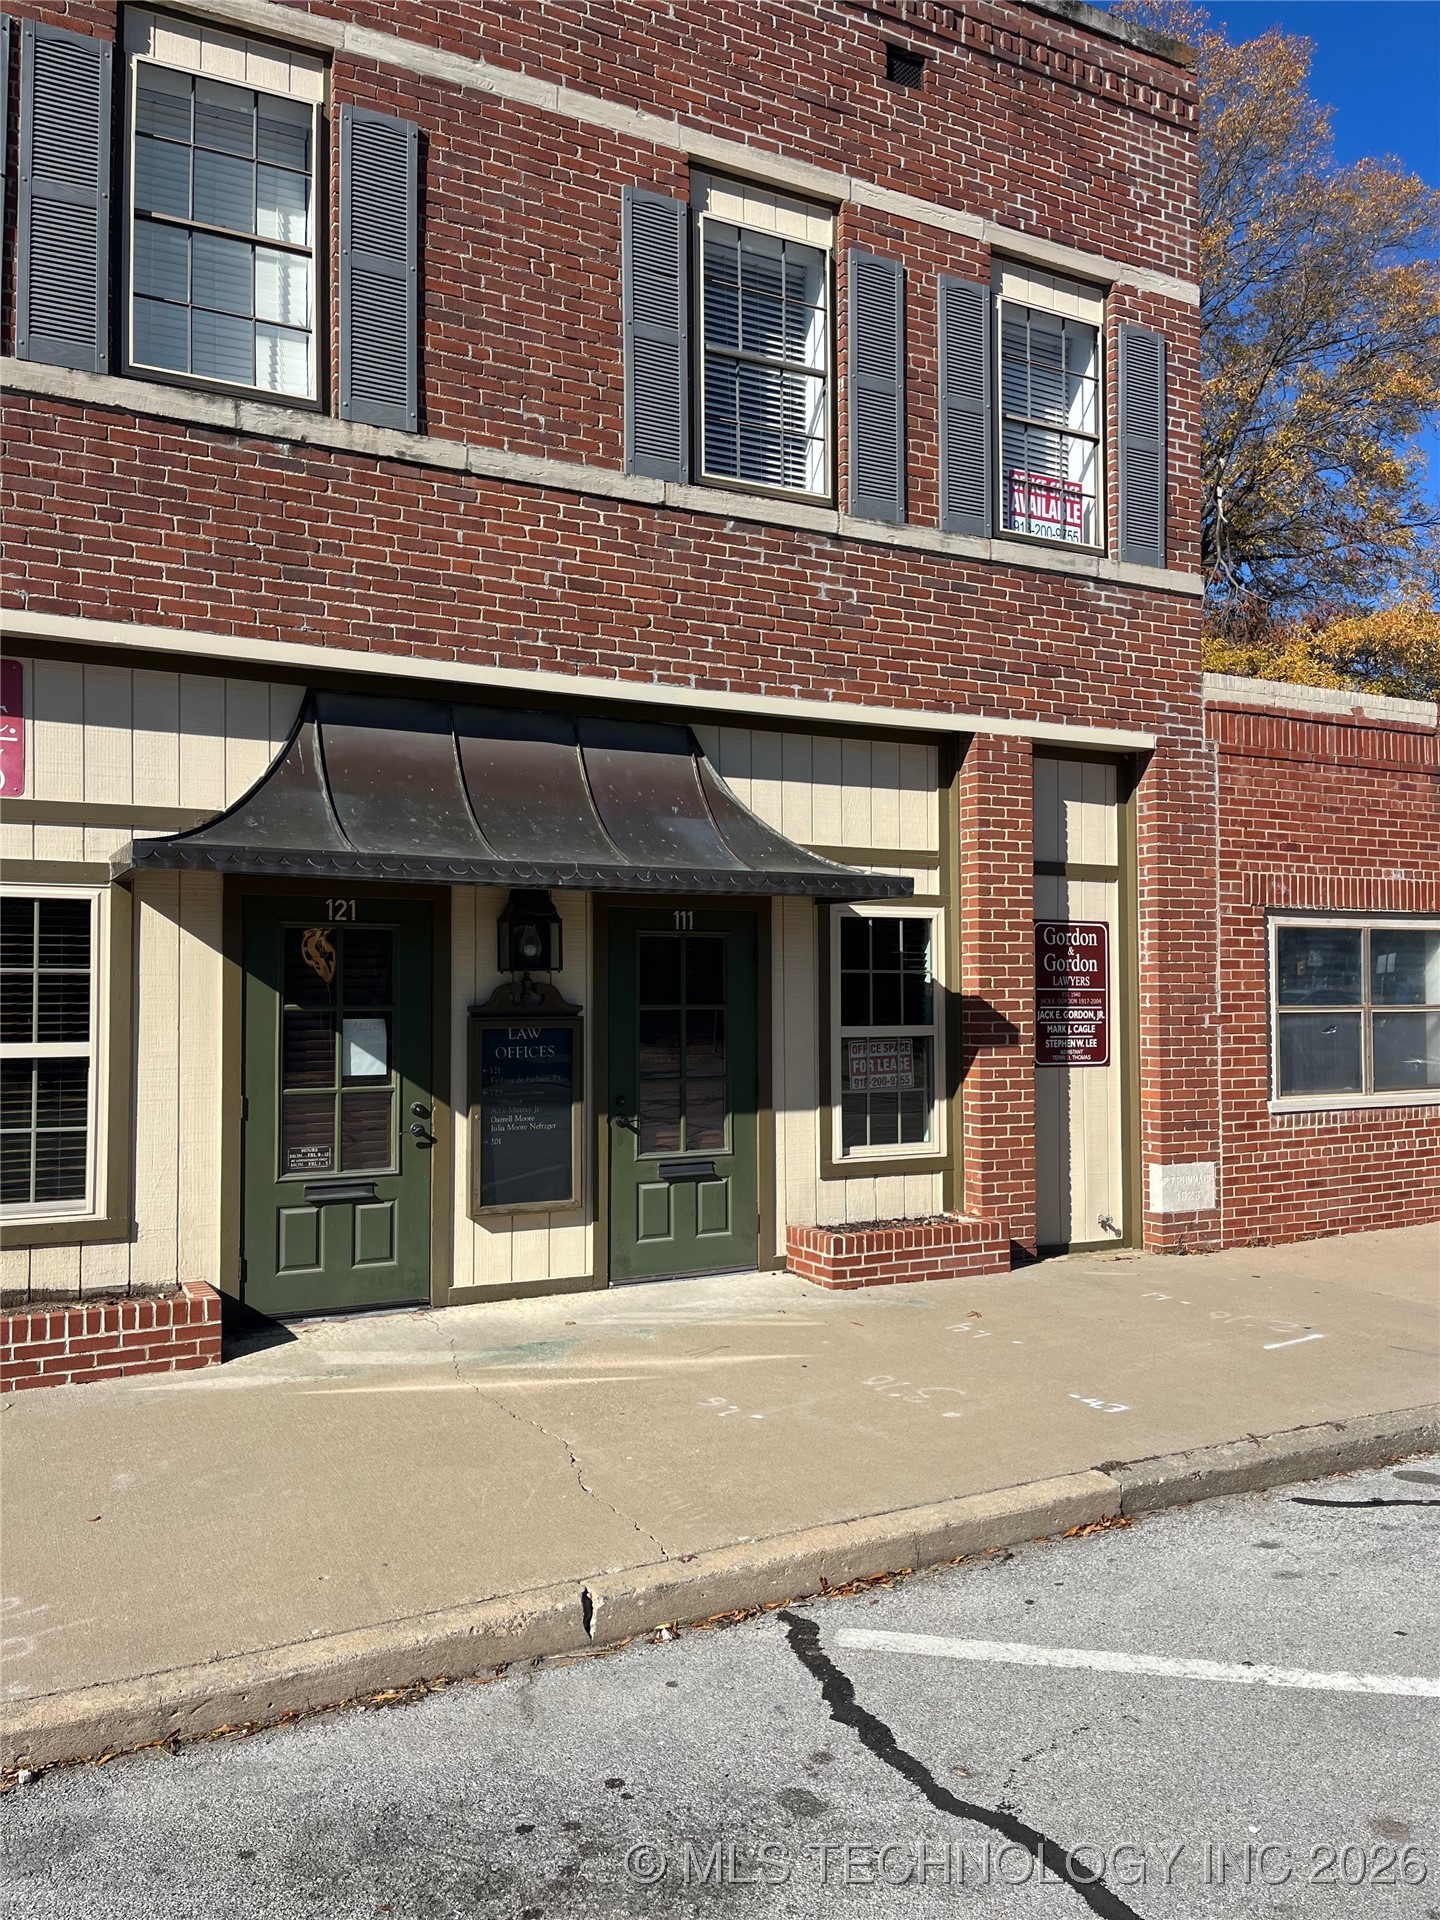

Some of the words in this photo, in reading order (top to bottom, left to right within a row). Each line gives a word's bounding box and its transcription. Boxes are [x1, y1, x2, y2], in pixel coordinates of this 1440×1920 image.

[325, 899, 356, 921] 121
[673, 910, 694, 930] 111
[1043, 926, 1098, 946] Gordon
[1067, 946, 1075, 956] &
[1043, 953, 1098, 972] Gordon
[1052, 976, 1090, 986] LAWYERS
[1036, 1010, 1055, 1021] JACK
[1055, 1010, 1062, 1019] E.
[1063, 1010, 1096, 1020] GORDON,
[1096, 1010, 1105, 1021] JR.
[508, 1028, 541, 1040] LAW
[1046, 1025, 1067, 1033] MARK
[1067, 1025, 1072, 1035] J.
[1073, 1024, 1096, 1033] CAGLE
[883, 1042, 910, 1053] SPACE
[1045, 1039, 1076, 1048] STEPHEN
[1076, 1039, 1085, 1047] W.
[1085, 1038, 1098, 1048] LEE
[495, 1045, 555, 1059] OFFICES
[852, 1060, 874, 1073] FOR
[490, 1115, 513, 1124] Darrell
[514, 1114, 536, 1122] Moore
[490, 1124, 505, 1133] Julia
[507, 1123, 528, 1131] Moore
